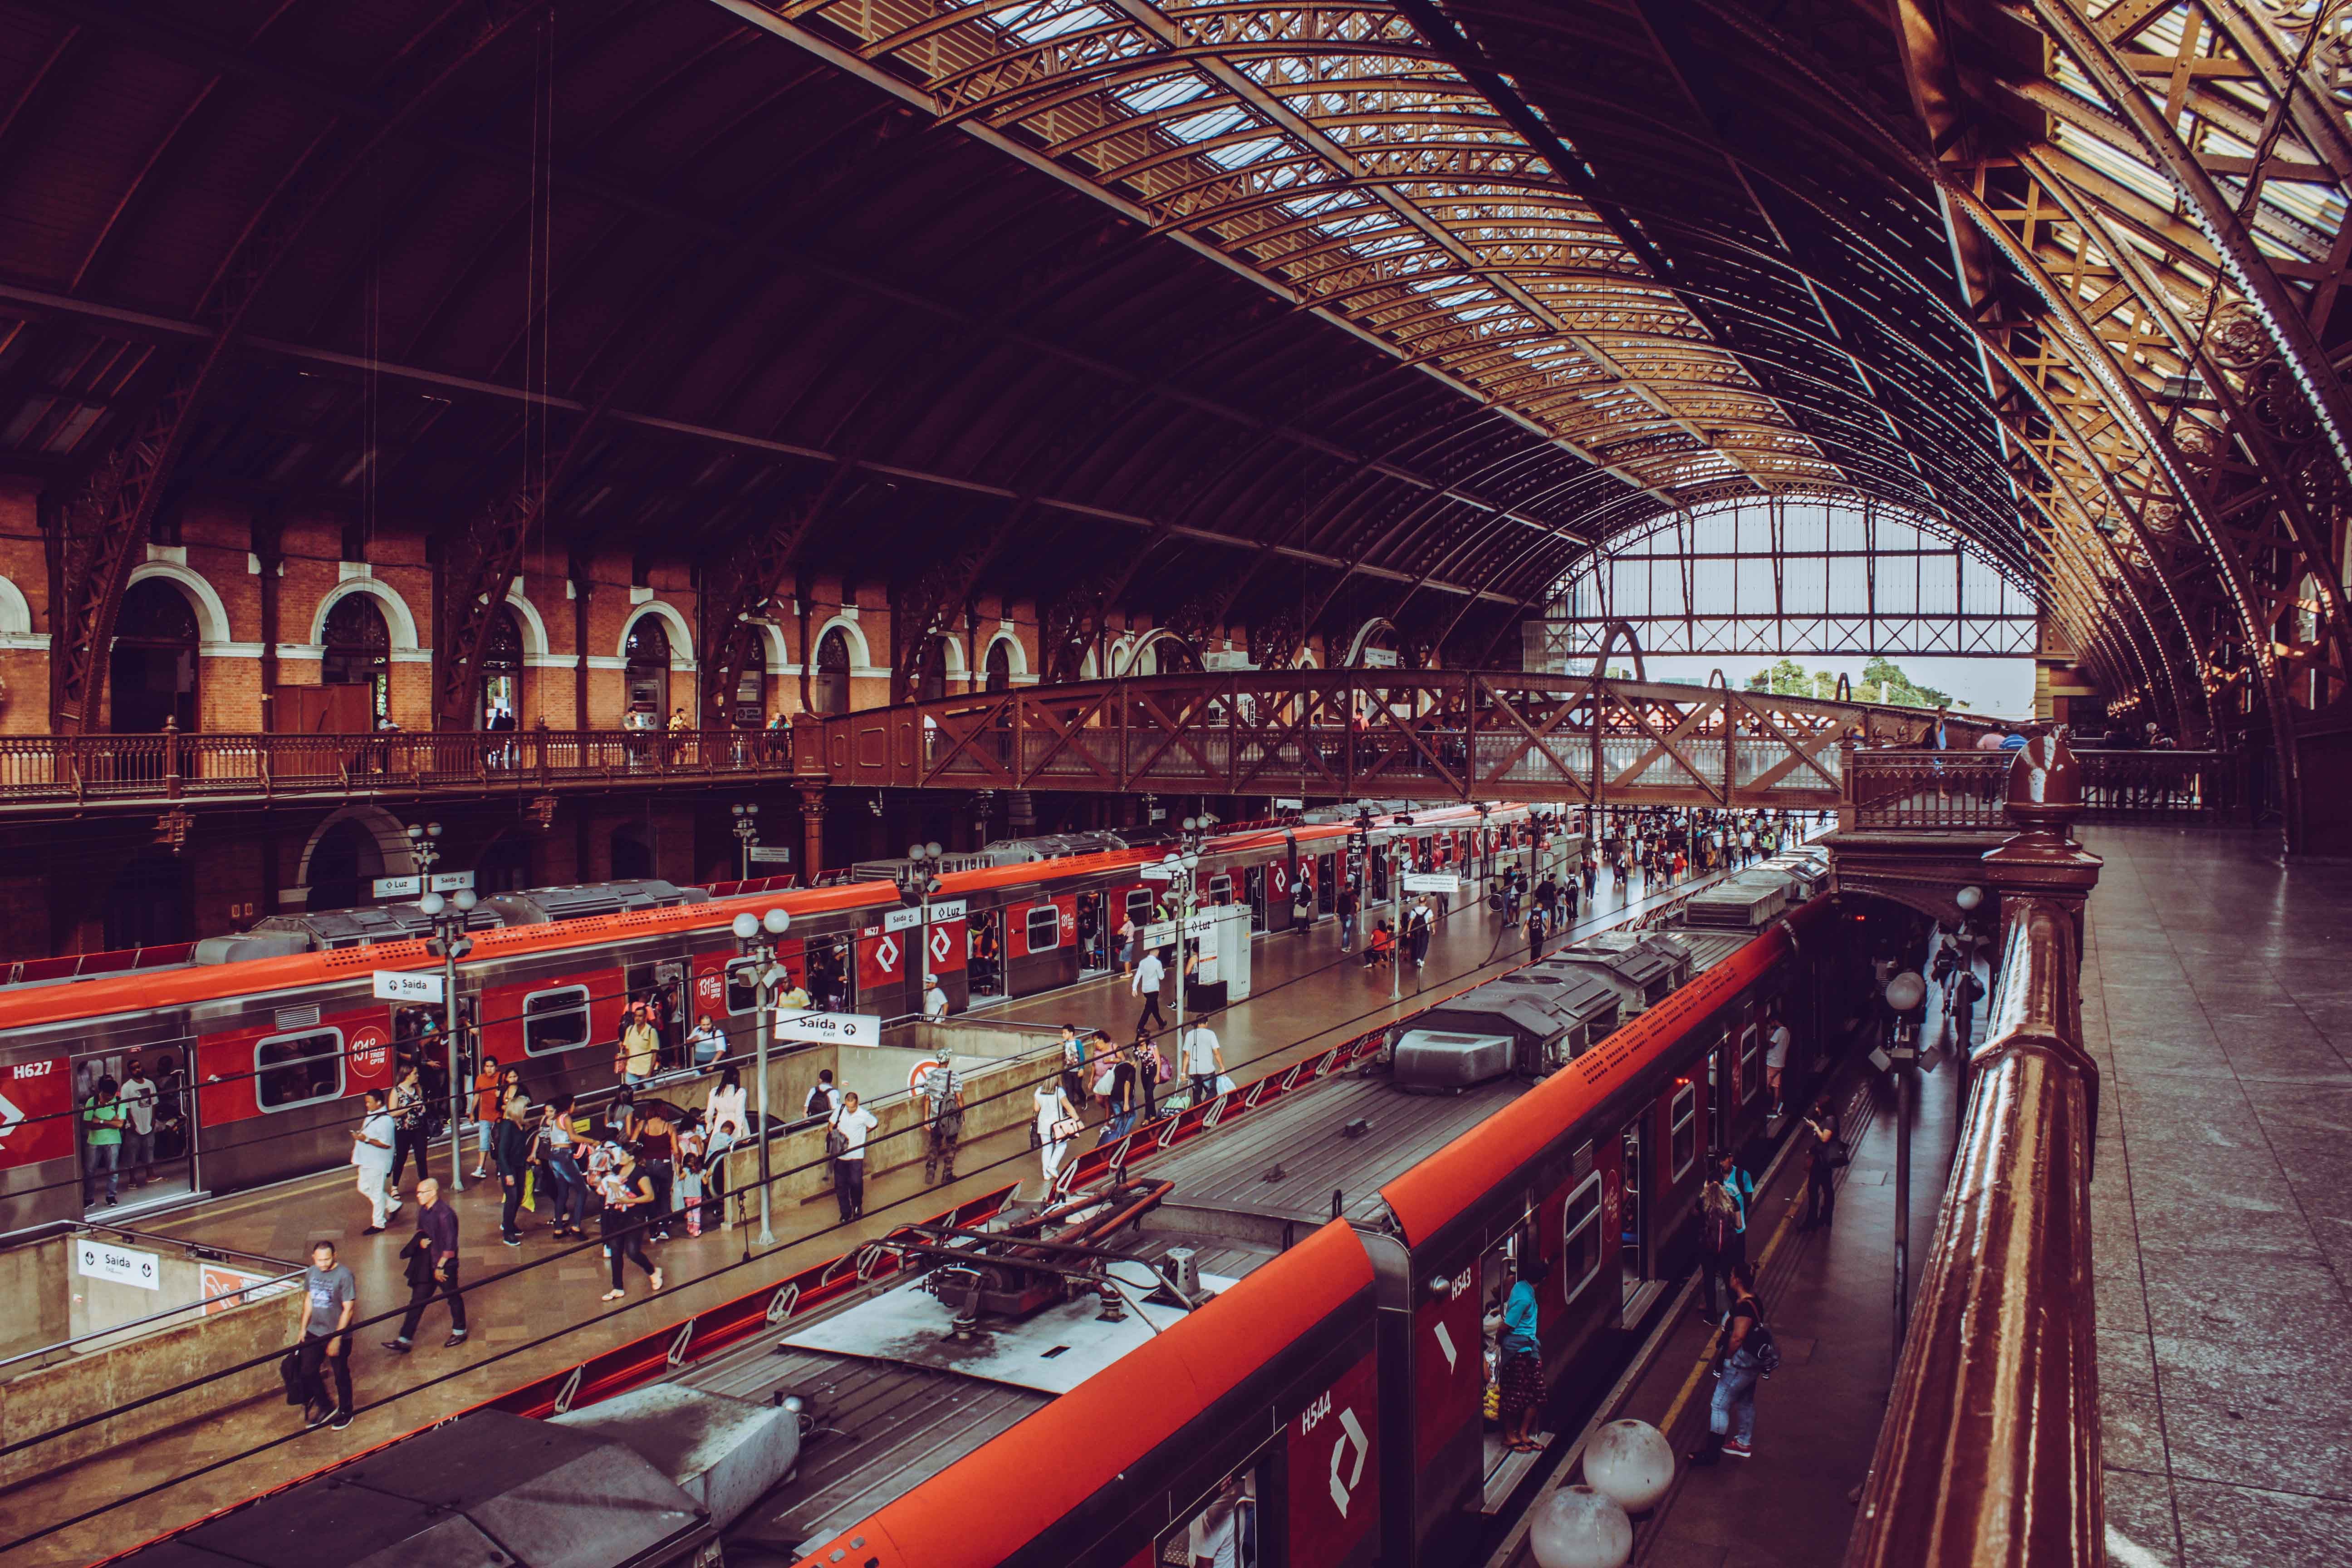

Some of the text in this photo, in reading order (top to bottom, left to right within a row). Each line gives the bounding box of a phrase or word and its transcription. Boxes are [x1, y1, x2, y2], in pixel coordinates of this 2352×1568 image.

[947, 907, 960, 917] Luz
[864, 926, 879, 936] H627
[1199, 920, 1211, 931] Luz
[799, 1017, 836, 1030] Saída
[370, 1057, 385, 1065] CPTM
[14, 1060, 53, 1079] H627
[1452, 1266, 1471, 1301] H543
[1302, 1390, 1331, 1436] H544
